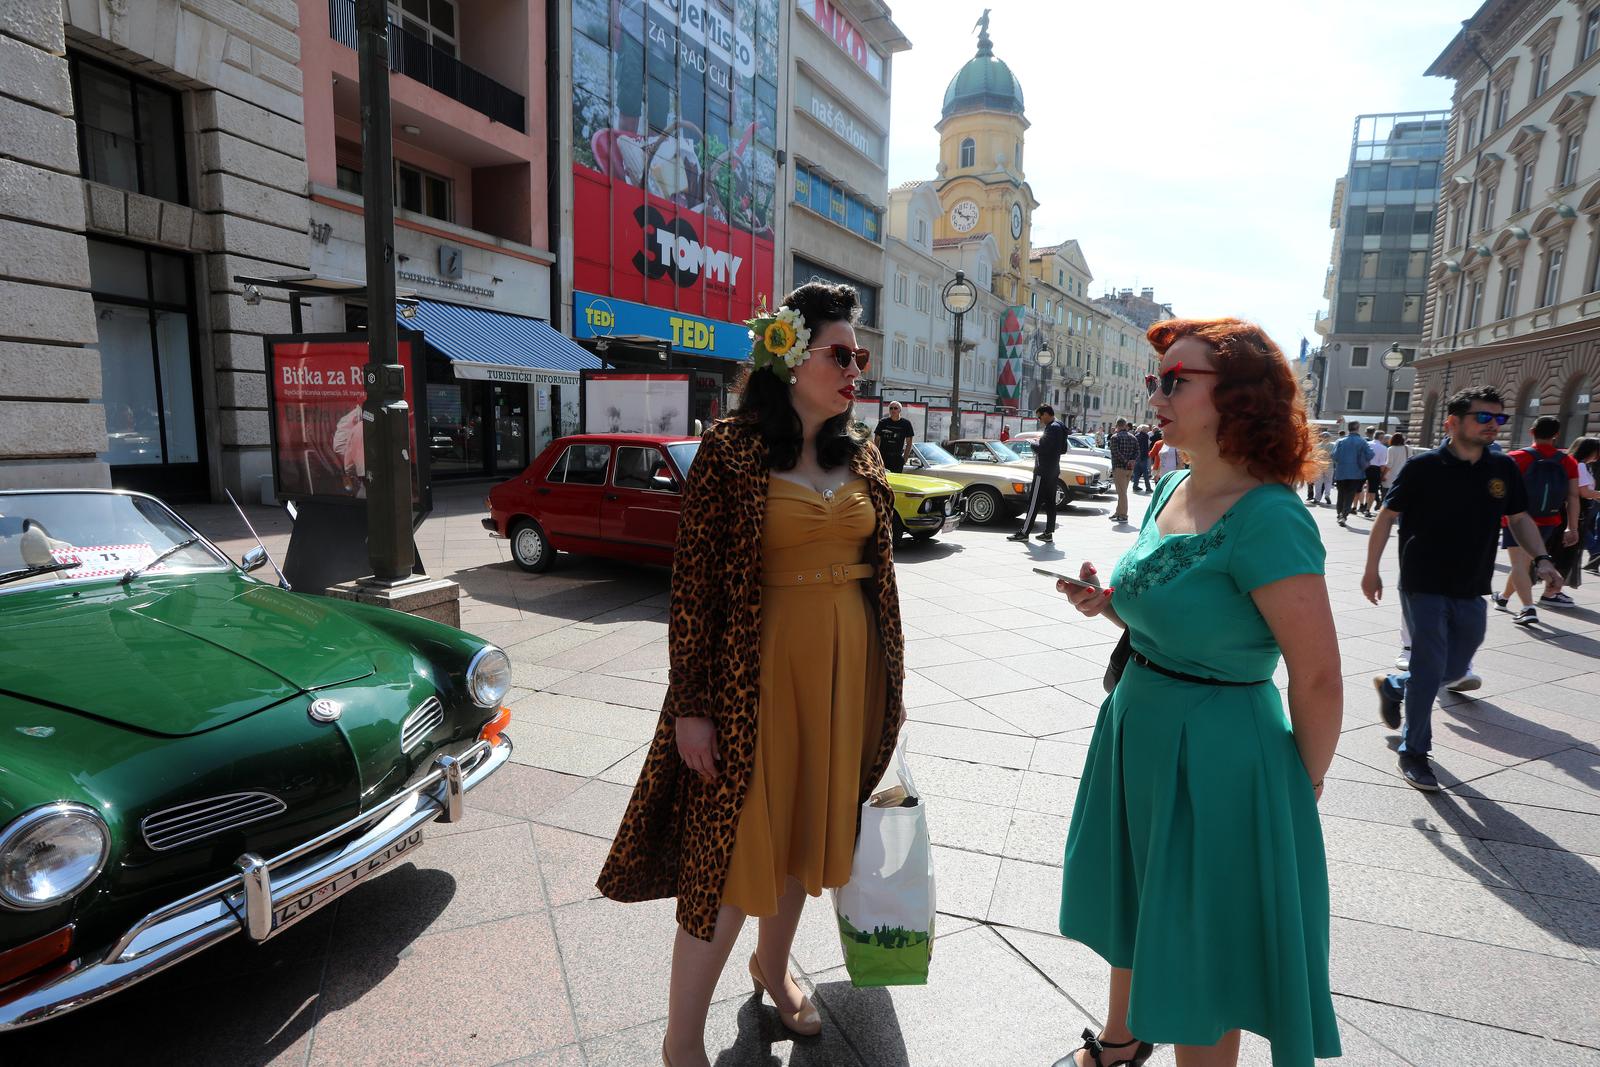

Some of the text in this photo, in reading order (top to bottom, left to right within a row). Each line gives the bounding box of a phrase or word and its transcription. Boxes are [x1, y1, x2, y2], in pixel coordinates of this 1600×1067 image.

[648, 20, 736, 93] ZA TRADCIJU
[811, 97, 870, 155] naš dom
[656, 227, 743, 286] TOMMY
[397, 270, 495, 298] TOURIST INFORMATION
[585, 307, 615, 328] TEDi
[669, 316, 715, 351] TEDi
[283, 366, 323, 385] Bitka
[327, 370, 346, 385] za
[100, 553, 120, 561] 73
